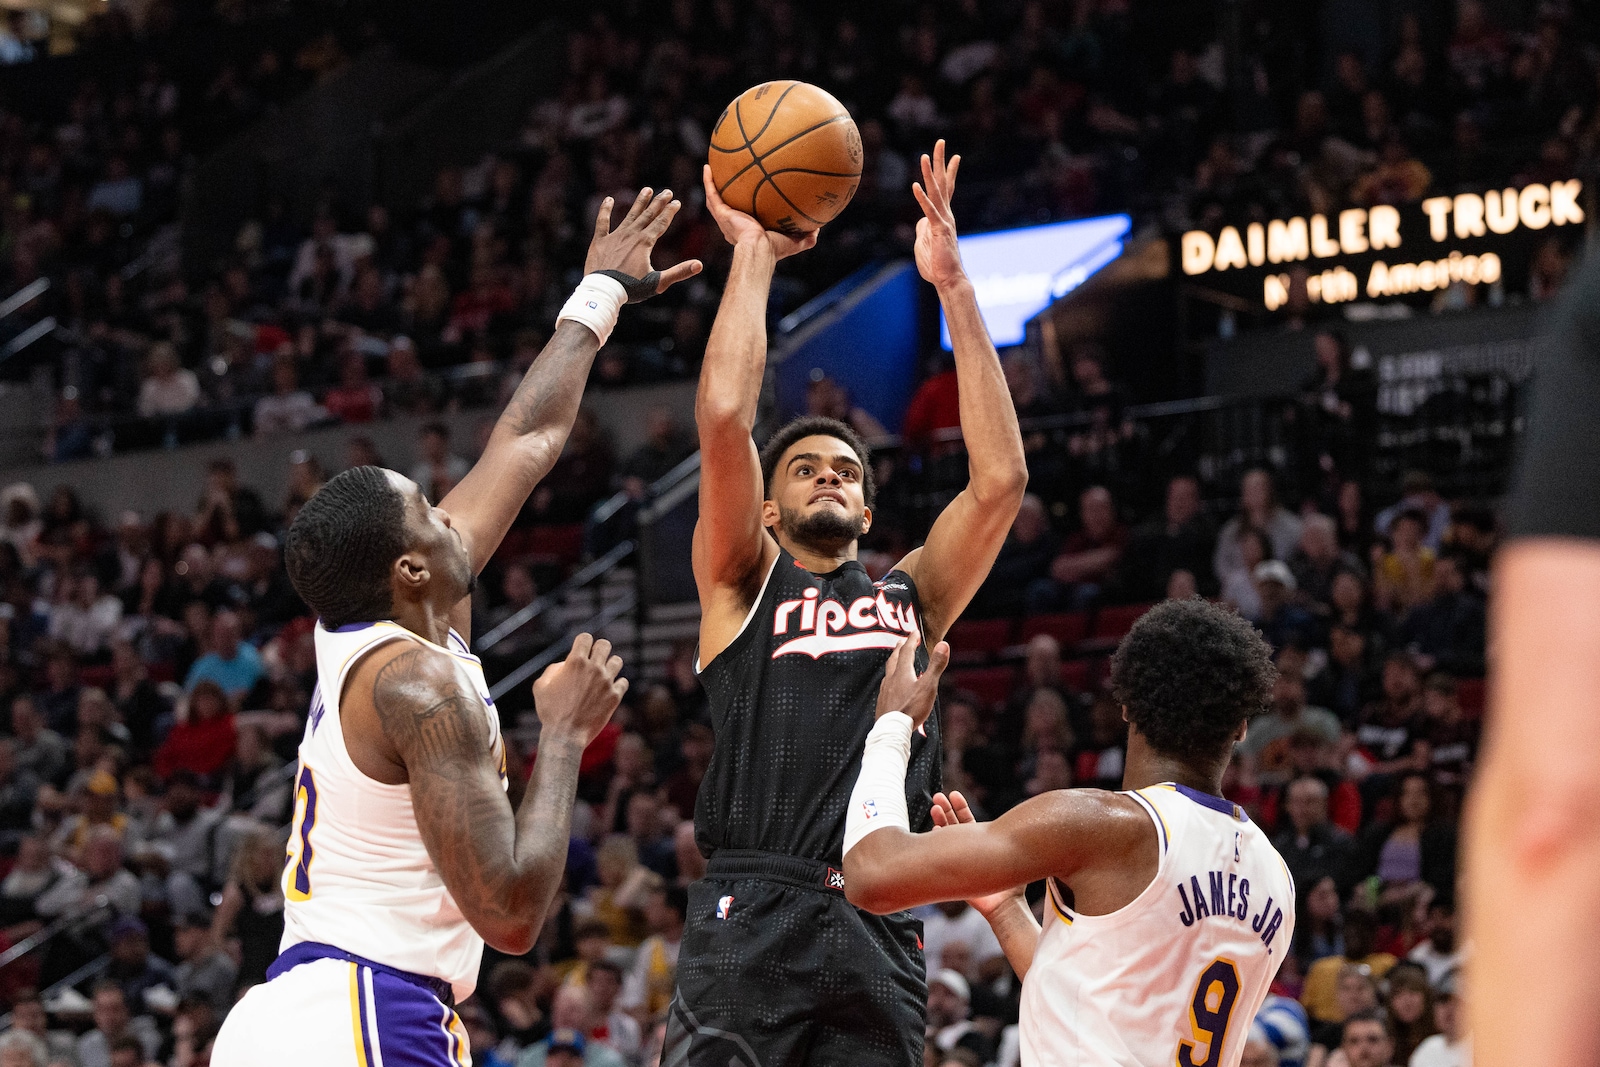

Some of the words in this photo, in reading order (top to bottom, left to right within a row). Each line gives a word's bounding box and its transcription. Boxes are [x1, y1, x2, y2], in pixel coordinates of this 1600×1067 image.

[1181, 204, 1402, 275] DAIMLER
[1422, 178, 1585, 243] TRUCK
[1263, 264, 1359, 312] Nrth
[1366, 250, 1501, 298] America
[1177, 871, 1250, 927] JAMES
[1252, 896, 1283, 955] JR.
[1176, 956, 1242, 1067] 9
